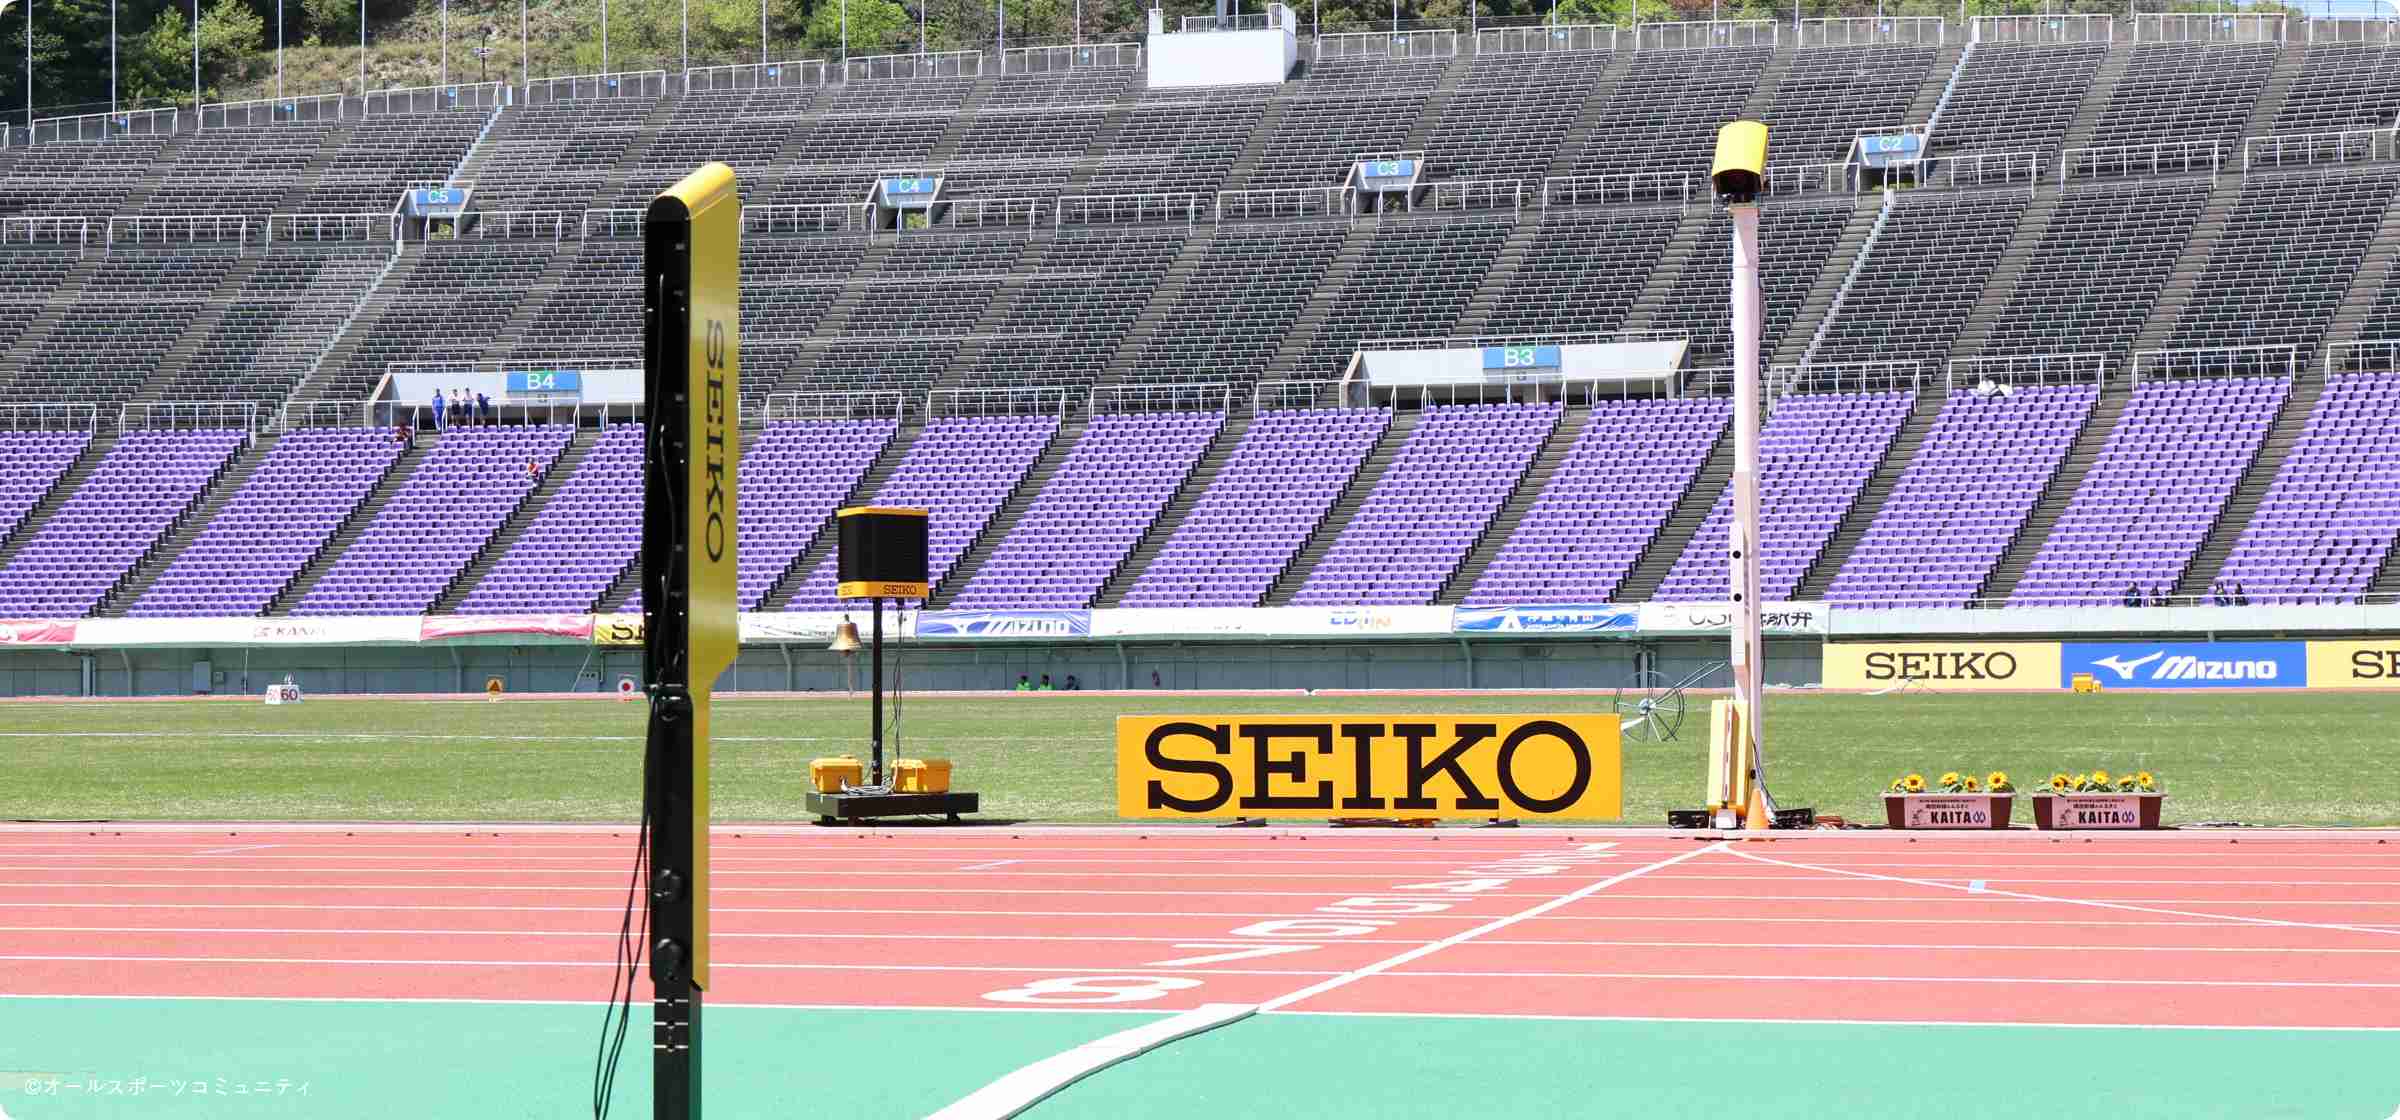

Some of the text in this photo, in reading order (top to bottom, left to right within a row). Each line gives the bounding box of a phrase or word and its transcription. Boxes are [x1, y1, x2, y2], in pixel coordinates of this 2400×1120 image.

[1880, 137, 1902, 150] C2
[1377, 160, 1399, 176] C3
[428, 189, 448, 203] C5
[1504, 349, 1535, 366] B3
[527, 372, 555, 389] B4
[706, 318, 724, 563] SEIKO
[883, 584, 917, 595] SEIKO
[1866, 651, 2016, 680] SEIKO
[280, 688, 298, 701] 60
[1144, 720, 1592, 814] SEIKO
[1931, 811, 1971, 825] KAITA
[2078, 811, 2120, 825] KAITA
[1314, 896, 1472, 913] 5
[1229, 918, 1397, 937] 6
[1143, 943, 1322, 967] 7
[981, 975, 1205, 1003] 8
